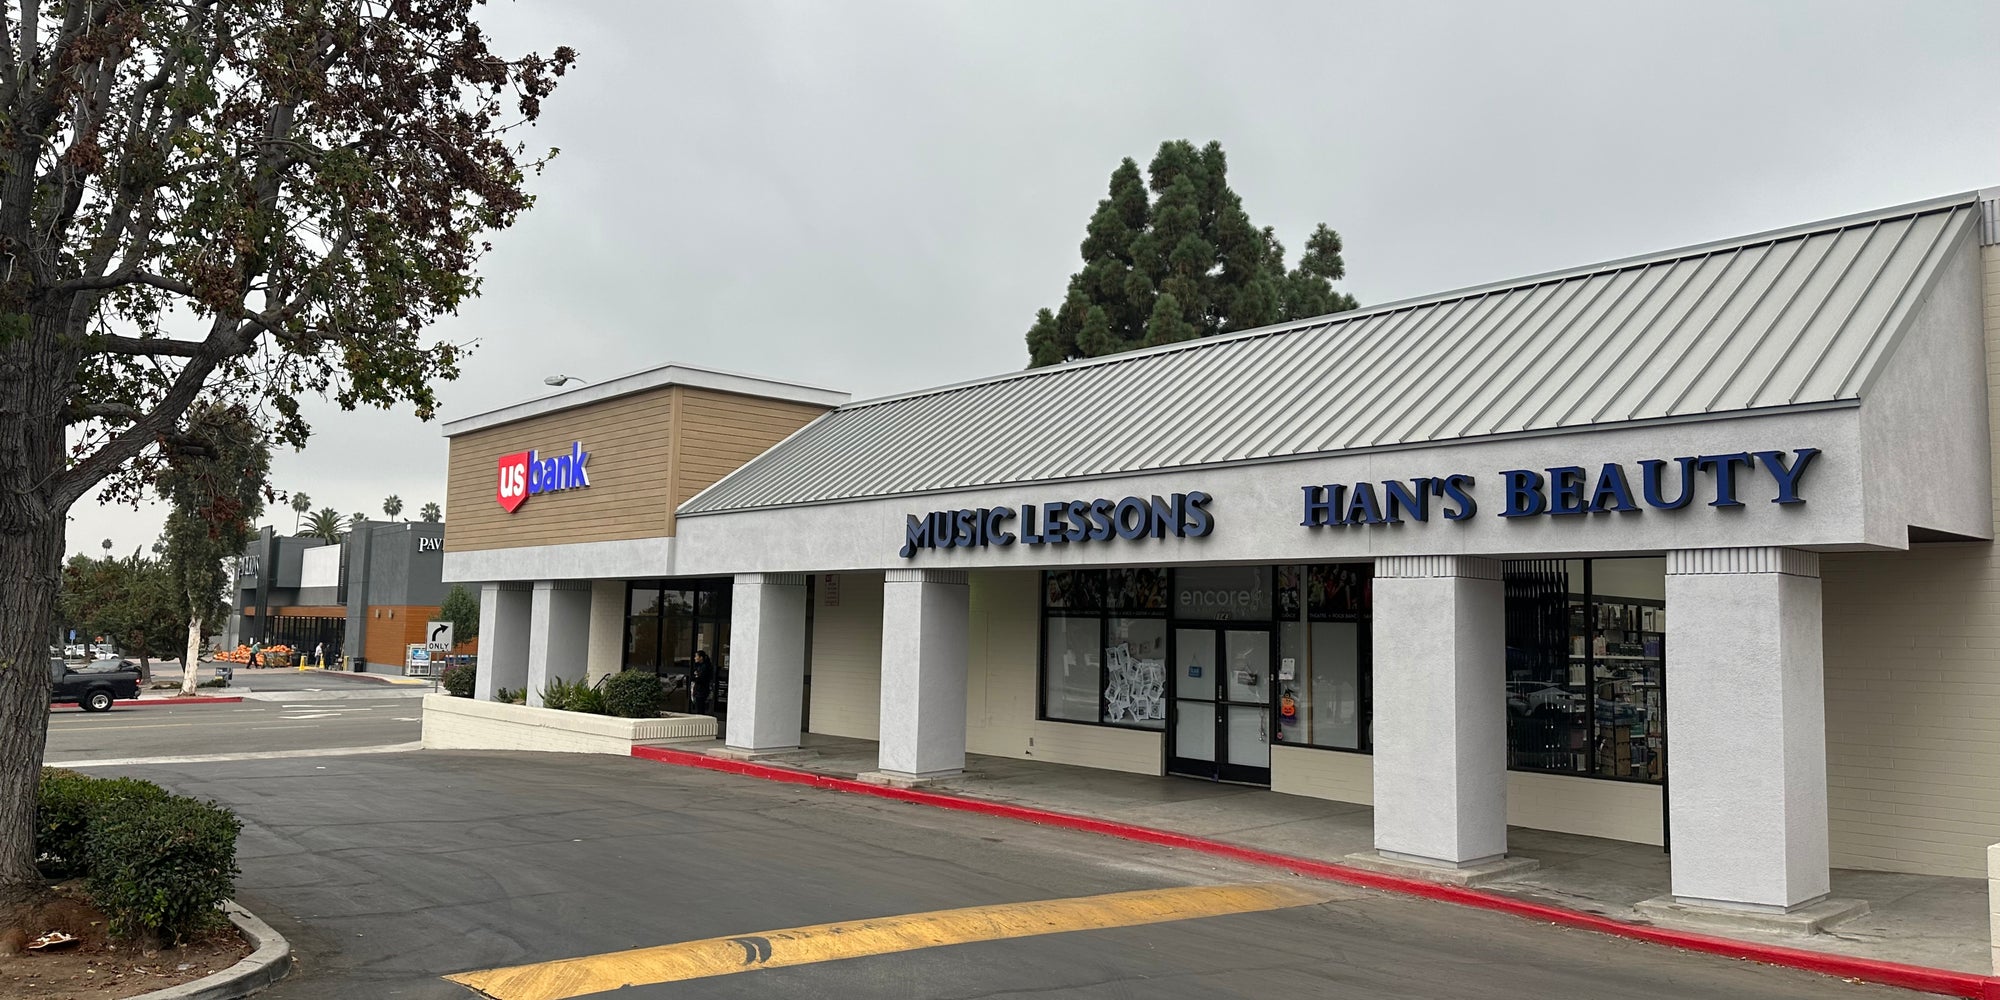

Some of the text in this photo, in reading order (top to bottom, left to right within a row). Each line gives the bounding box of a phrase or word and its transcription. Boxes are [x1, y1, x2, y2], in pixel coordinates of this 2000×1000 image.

[500, 441, 591, 498] us bank
[1301, 447, 1822, 527] HAN'S BEAUTY
[899, 490, 1215, 558] MUSIC LESSONS
[418, 537, 443, 552] PAV
[1180, 590, 1251, 606] encore
[428, 642, 450, 650] ONLY
